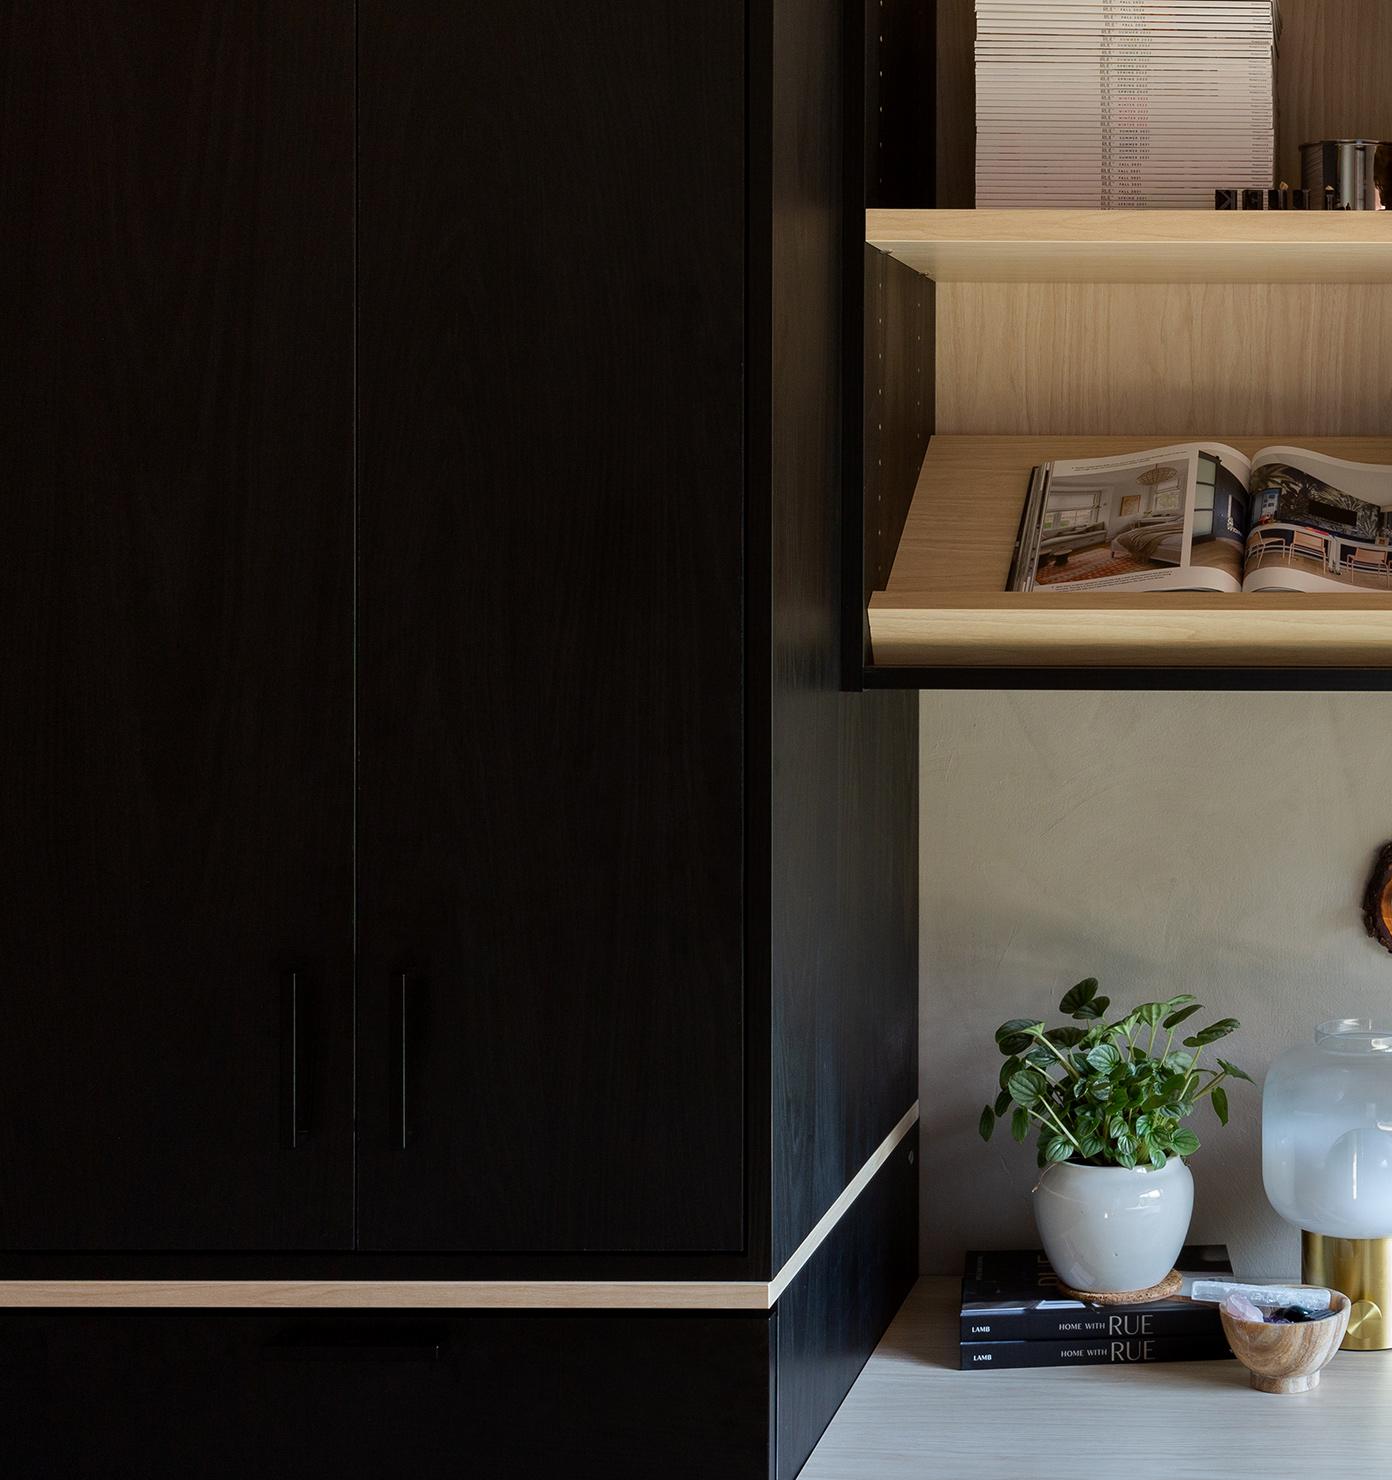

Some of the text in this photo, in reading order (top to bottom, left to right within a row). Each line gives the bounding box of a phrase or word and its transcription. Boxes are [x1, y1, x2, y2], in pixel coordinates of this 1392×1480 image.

[1058, 1323, 1082, 1331] HOME
[1084, 1322, 1106, 1330] WITH
[1109, 1314, 1154, 1336] RUE
[1060, 1350, 1084, 1358] HOME
[1086, 1348, 1108, 1357] WITH
[1111, 1340, 1156, 1362] RUE
